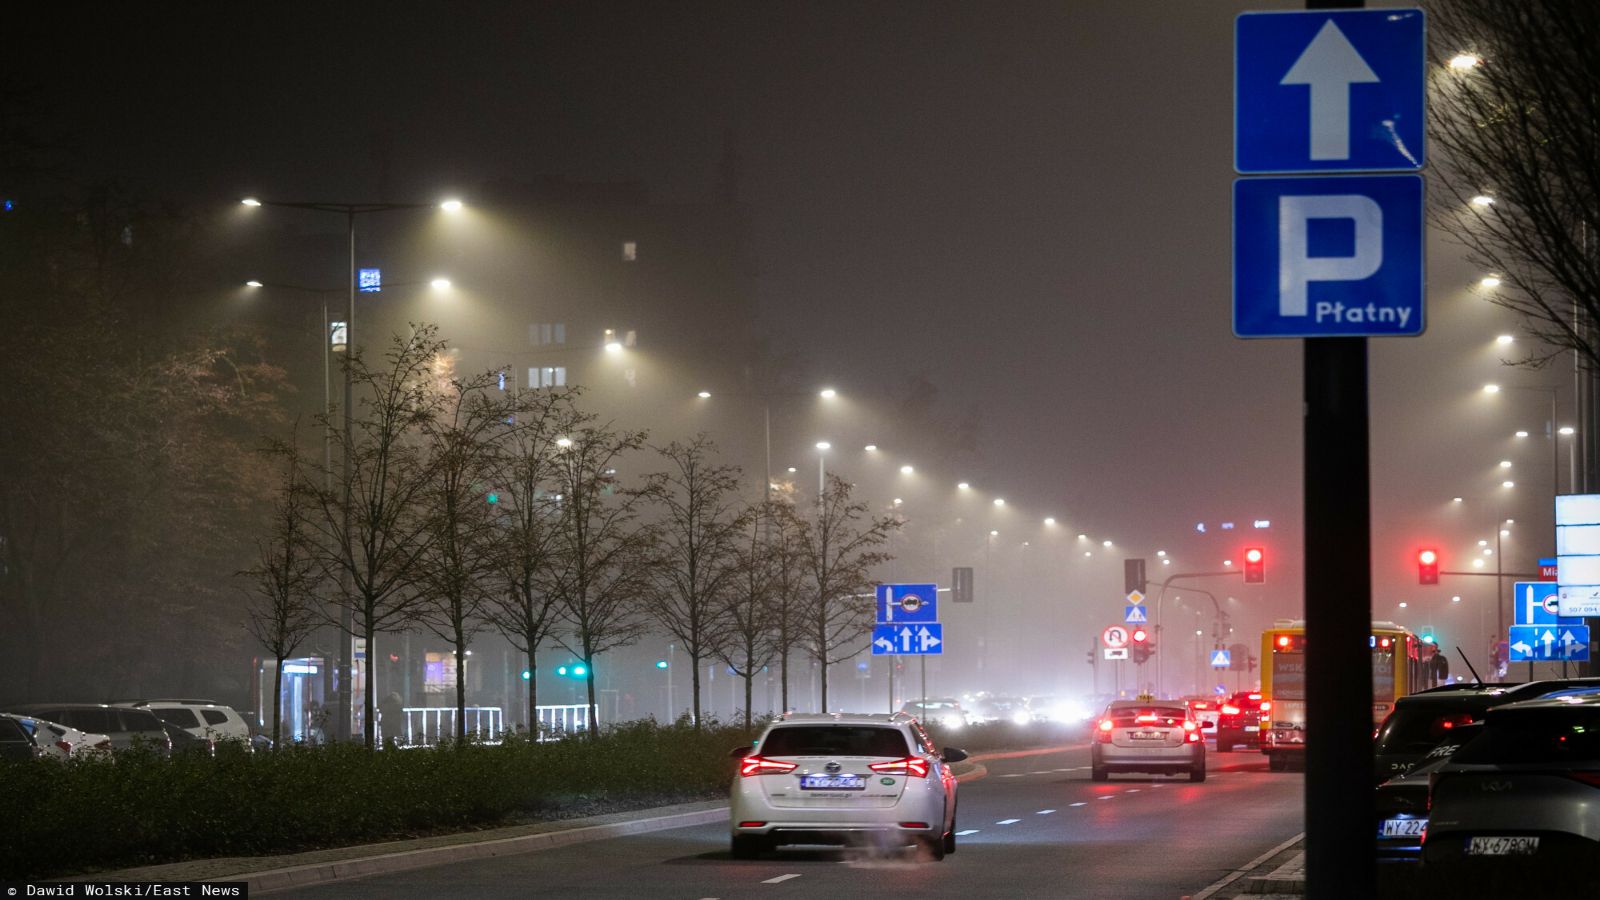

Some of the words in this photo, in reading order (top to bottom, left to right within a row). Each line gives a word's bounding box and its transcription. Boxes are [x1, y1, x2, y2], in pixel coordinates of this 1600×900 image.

[1279, 194, 1383, 317] P
[1316, 301, 1412, 328] Płatny
[1386, 821, 1402, 835] WY
